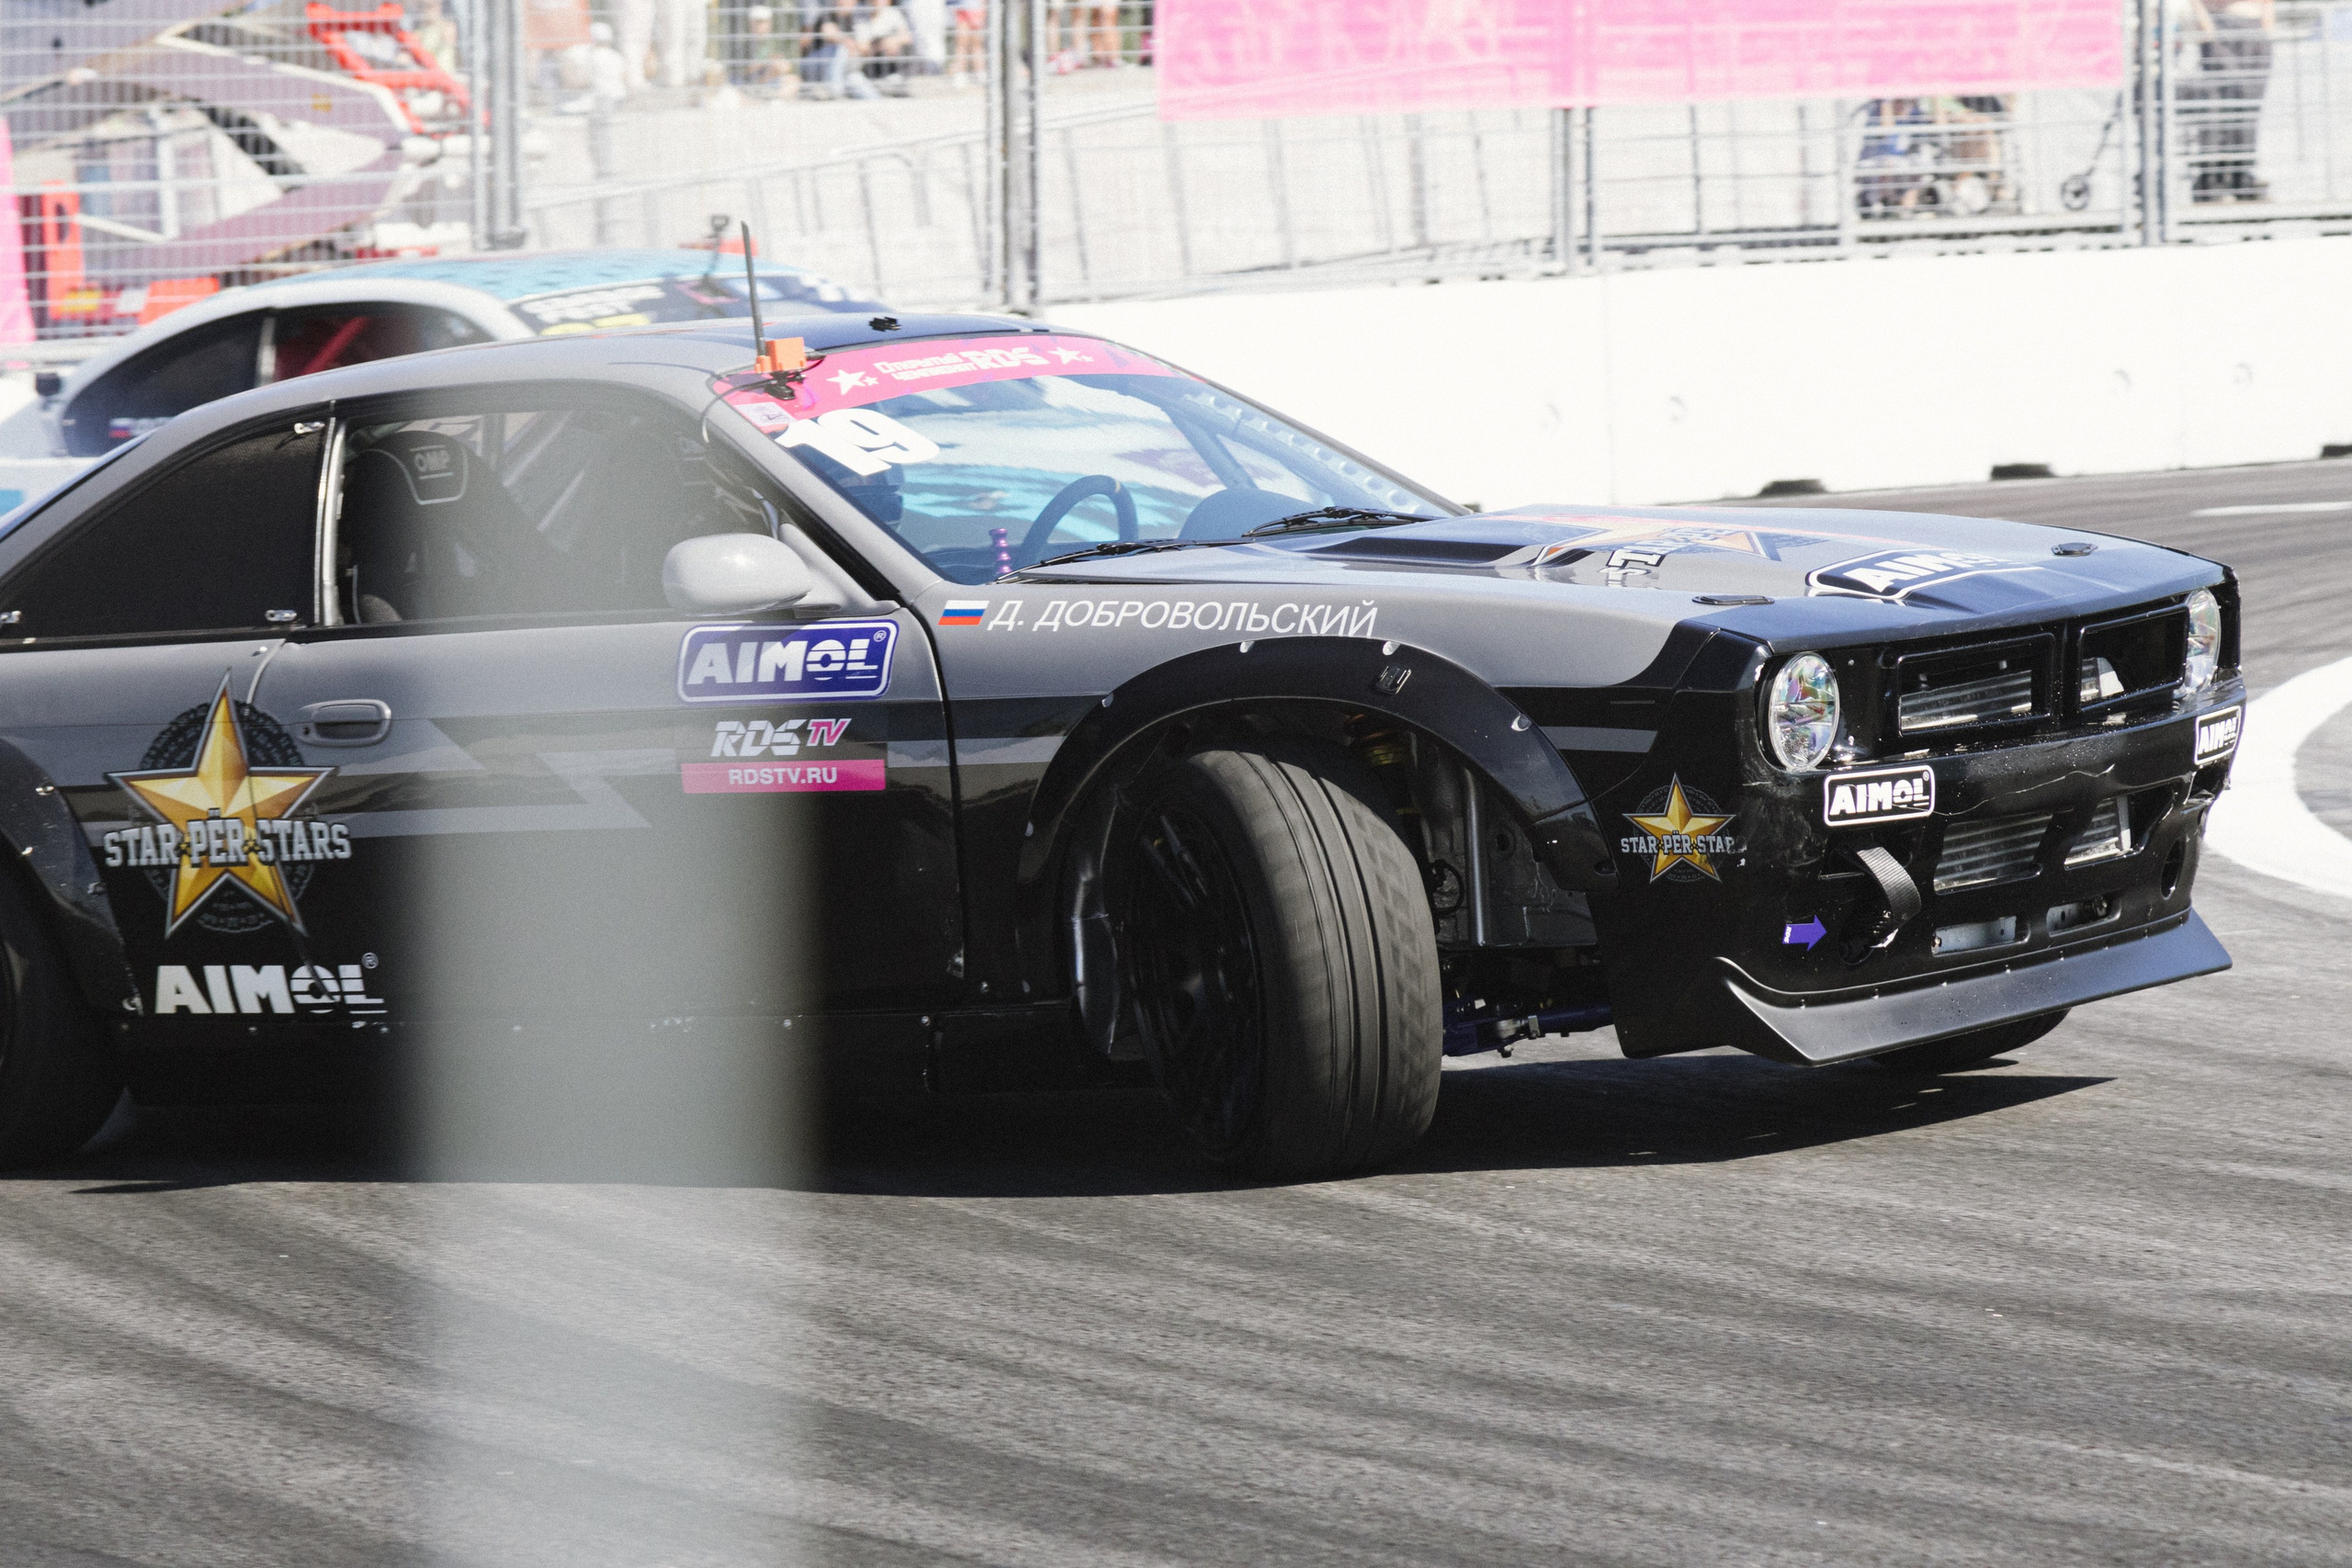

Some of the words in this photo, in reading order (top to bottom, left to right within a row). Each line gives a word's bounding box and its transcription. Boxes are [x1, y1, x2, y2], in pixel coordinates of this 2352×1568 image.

[958, 346, 1051, 370] RDS
[774, 408, 941, 476] 19
[987, 600, 1024, 631] Д.
[1033, 600, 1379, 637] ДОБРОВОЛЬСКИЙ
[686, 638, 878, 685] AIMOL
[729, 766, 838, 786] RDSTV.RU
[1829, 778, 1930, 816] AIMOL
[103, 823, 180, 867] STAR
[256, 818, 352, 863] STARS
[1621, 836, 1659, 853] STAR
[155, 964, 388, 1014] AIMOL
